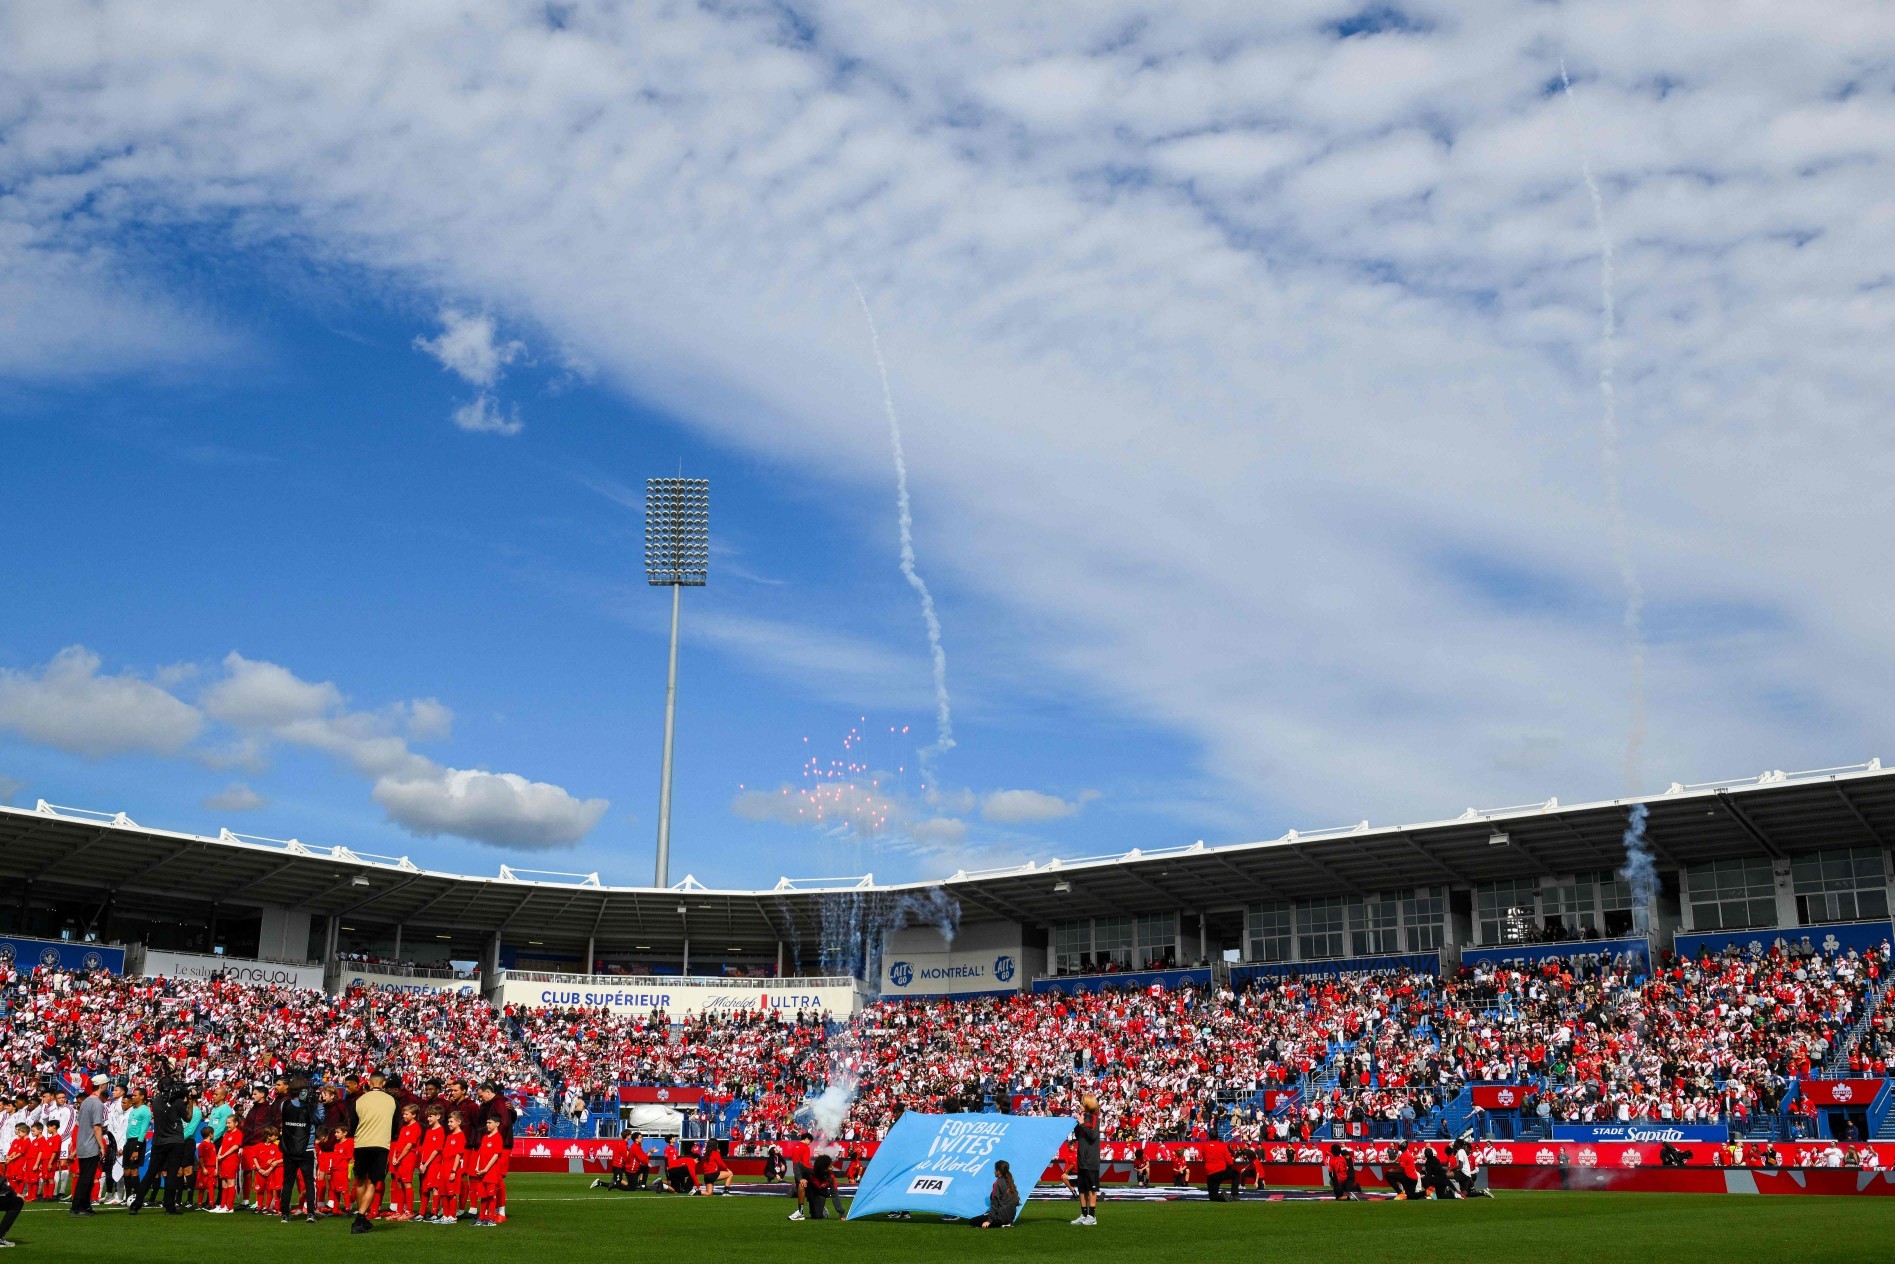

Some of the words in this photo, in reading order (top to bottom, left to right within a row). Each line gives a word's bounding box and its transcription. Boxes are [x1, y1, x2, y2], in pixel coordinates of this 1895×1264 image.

[175, 964, 188, 975] Le
[1001, 970, 1010, 980] GO
[898, 976, 907, 985] GO
[541, 990, 580, 1005] CLUB
[584, 990, 671, 1007] SUPÉRIEUR
[702, 995, 756, 1008] Michelob
[770, 995, 821, 1008] ULTRA
[1592, 1127, 1624, 1135] STADE
[1625, 1126, 1684, 1142] Saputo
[932, 1154, 990, 1177] World
[914, 1179, 943, 1191] FIFA
